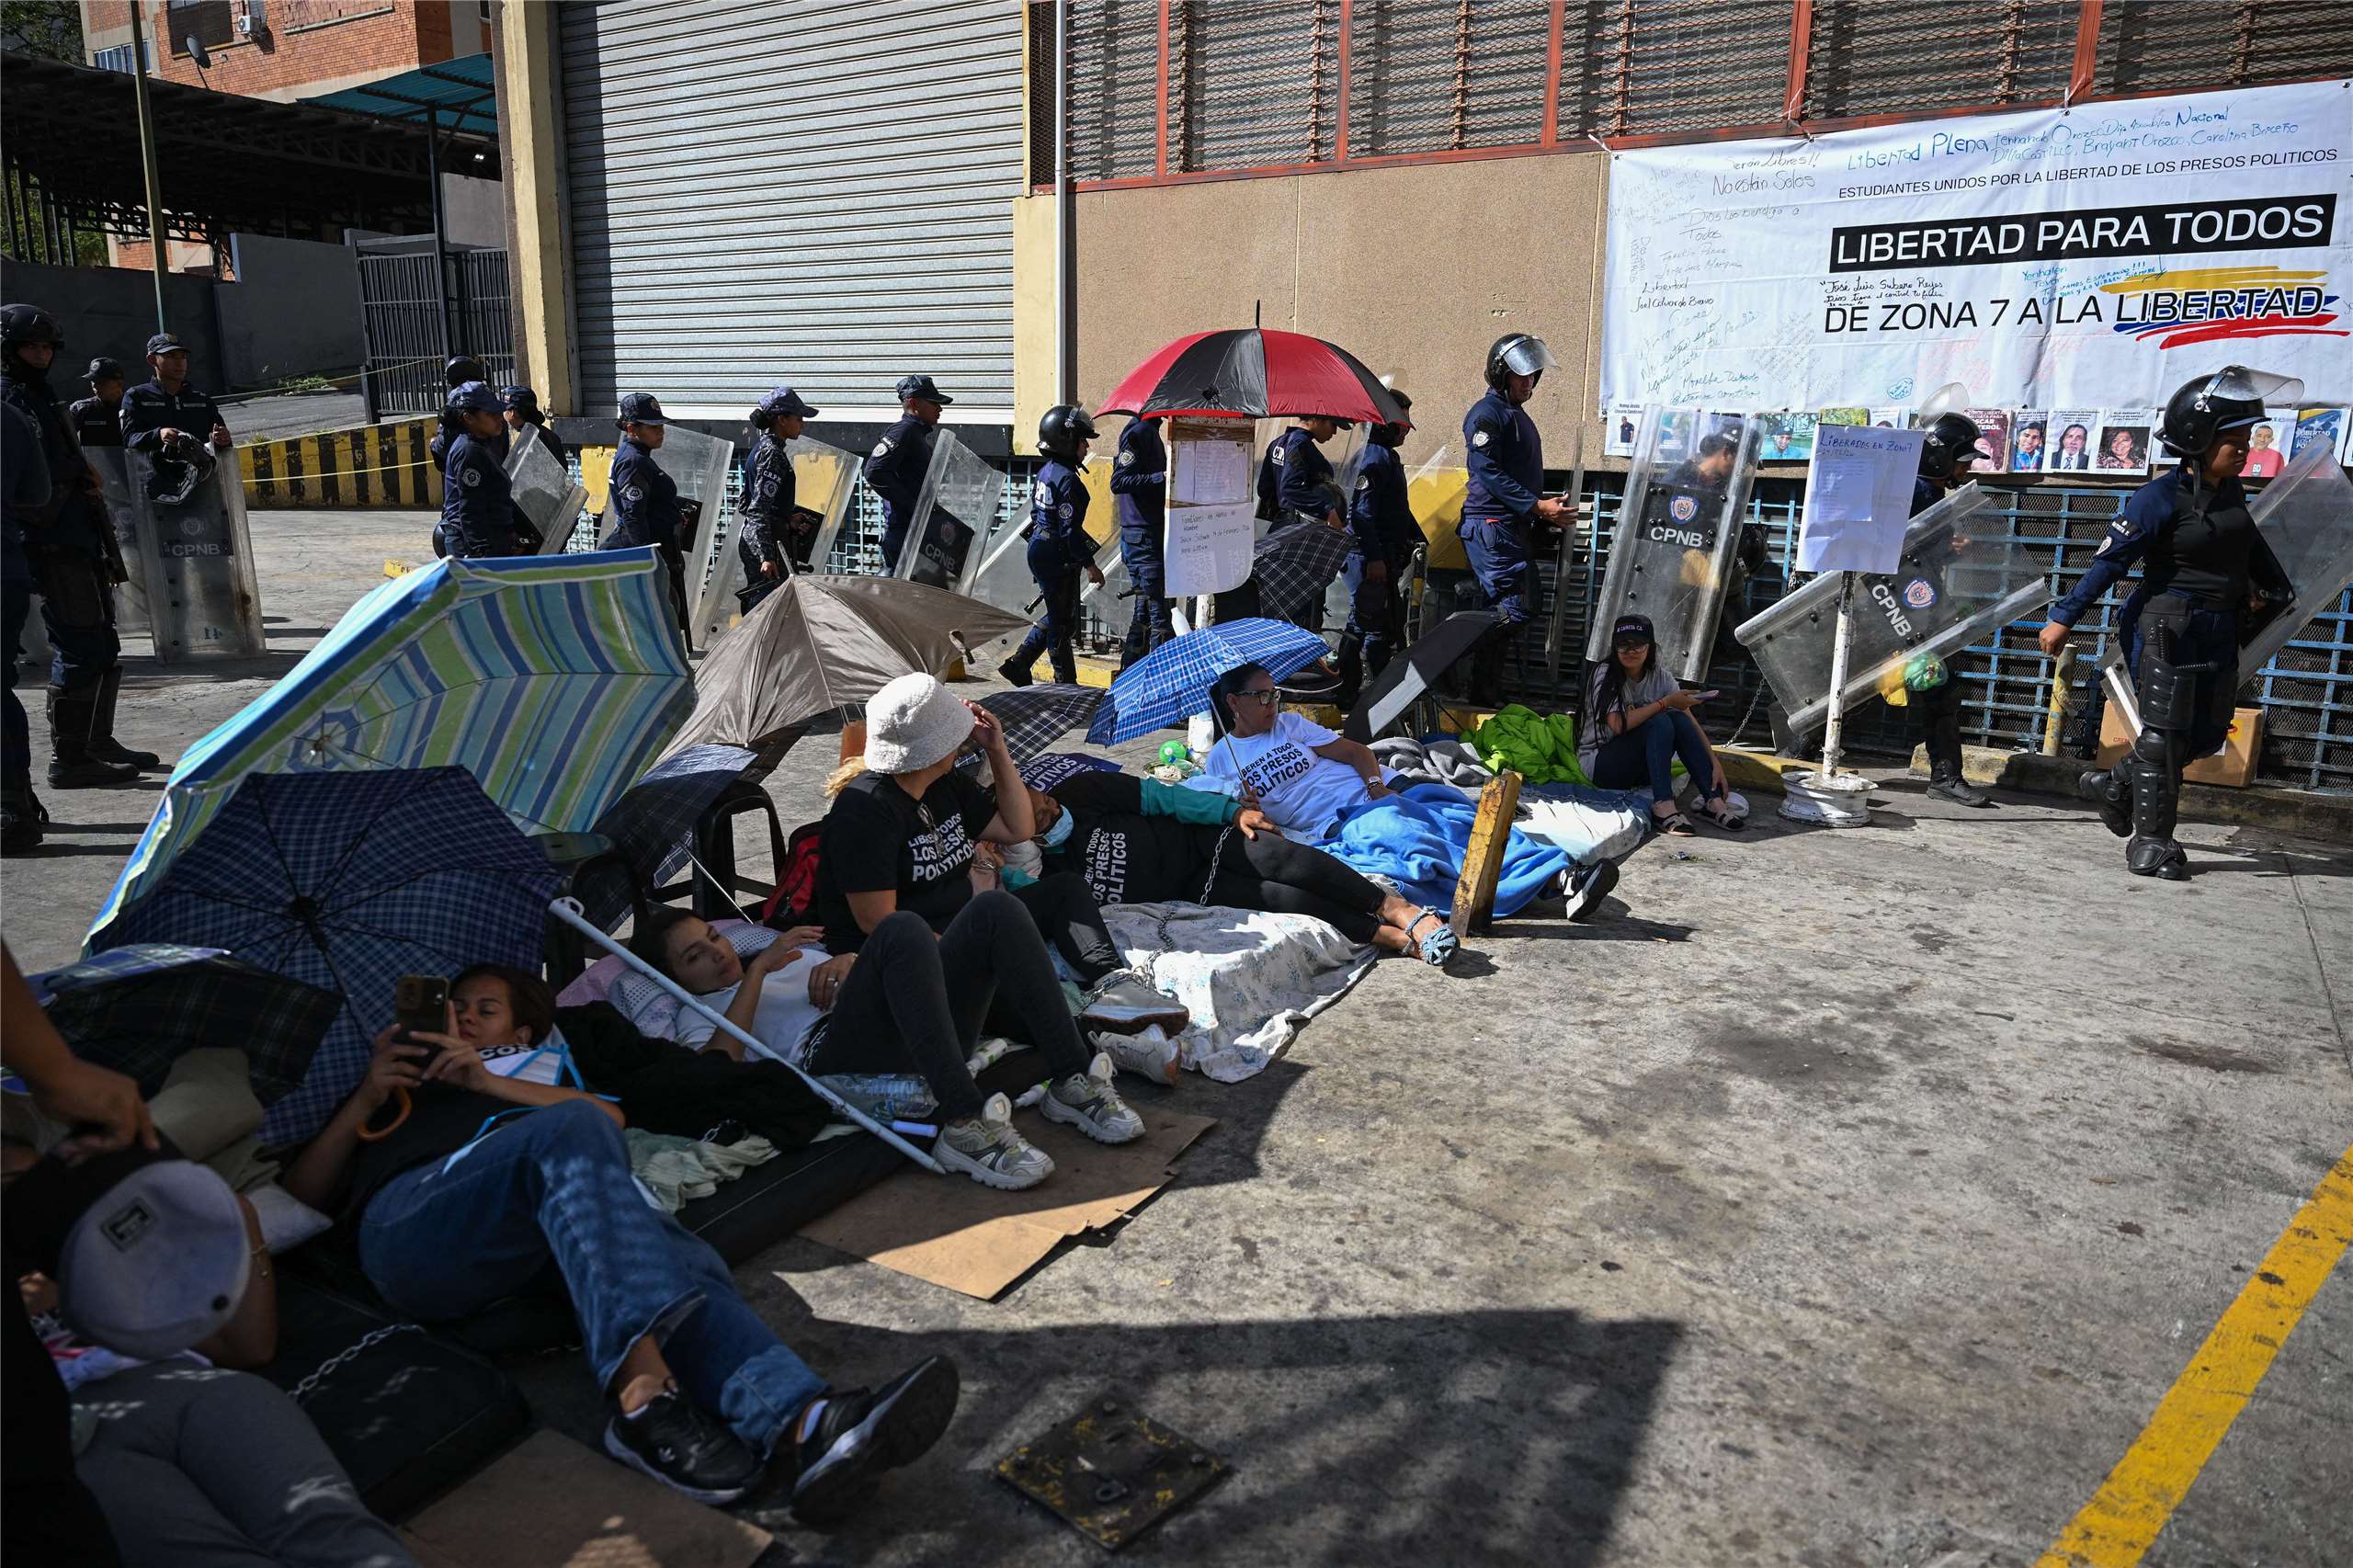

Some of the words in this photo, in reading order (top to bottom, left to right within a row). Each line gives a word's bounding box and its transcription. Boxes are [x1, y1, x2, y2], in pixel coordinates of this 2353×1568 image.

[1838, 180, 1931, 199] ESTUDIANTES
[1934, 176, 1987, 191] UNIDOS
[1990, 173, 2020, 187] POR
[2024, 171, 2042, 184] LA
[2046, 165, 2118, 182] LIBERTAD
[2121, 164, 2142, 176] DE
[2145, 160, 2176, 175] LOS
[2179, 154, 2245, 172] PRESOS
[2249, 148, 2338, 165] POLITICOS
[1836, 222, 2025, 265] LIBERTAD
[2036, 214, 2152, 252] PARA
[2164, 204, 2325, 245] TODOS
[1824, 305, 1870, 334] DE
[1879, 301, 1978, 332] ZONA
[1989, 299, 2010, 326] 7
[2016, 297, 2043, 324] A
[2055, 294, 2103, 324] LA
[2115, 285, 2325, 324] LIBERTAD
[172, 543, 221, 557] CPNB
[1650, 526, 1703, 549] CPNB
[925, 543, 956, 571] CPNB
[1871, 584, 1912, 638] CPNB
[1029, 757, 1077, 792] UTIVOS
[1241, 756, 1266, 778] BEREN
[1246, 770, 1262, 787] OS
[1261, 748, 1303, 777] PRESOS
[1256, 756, 1310, 798] OLÍTICOS
[912, 845, 938, 861] LOS
[1106, 832, 1127, 904] OLÍTICOS
[1091, 882, 1107, 902] OS
